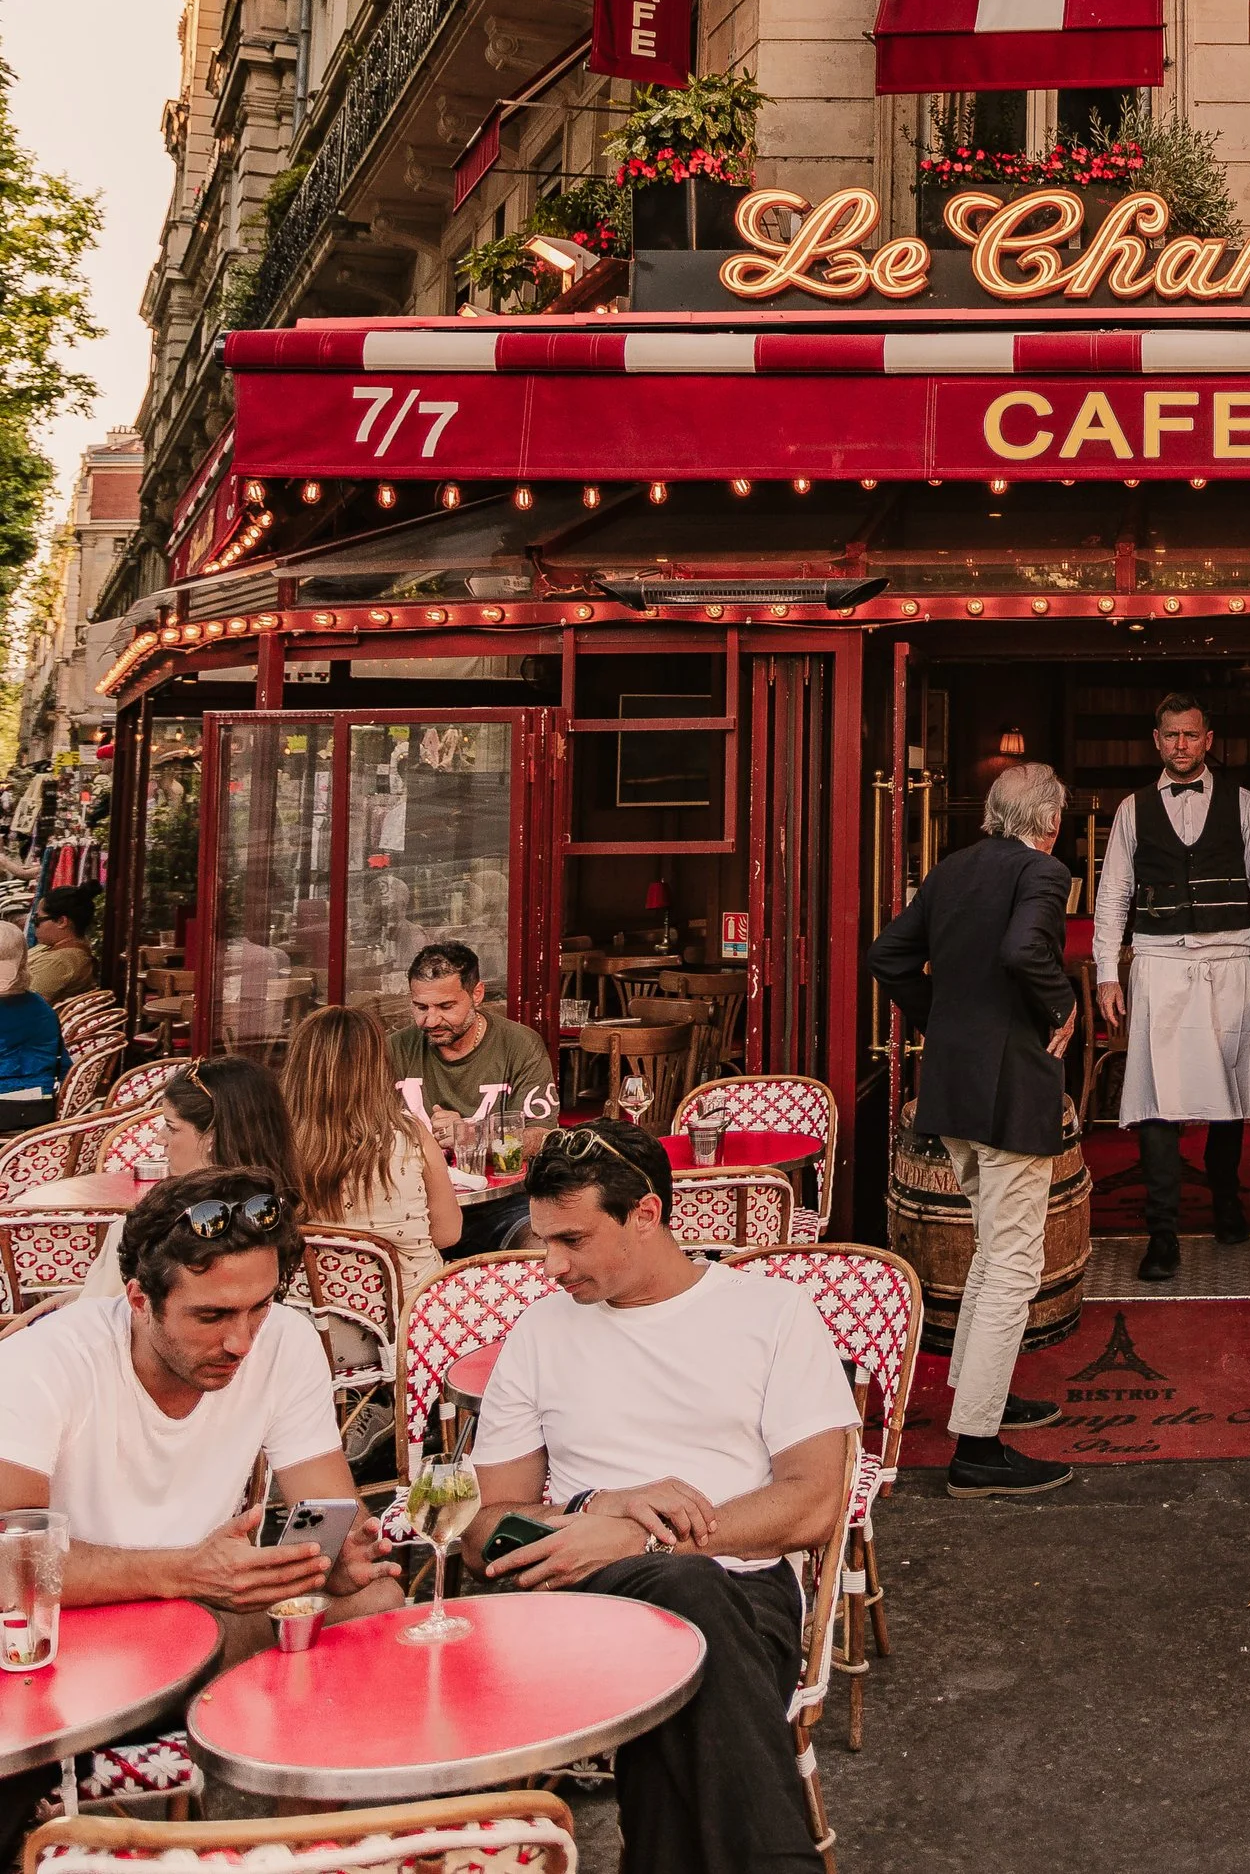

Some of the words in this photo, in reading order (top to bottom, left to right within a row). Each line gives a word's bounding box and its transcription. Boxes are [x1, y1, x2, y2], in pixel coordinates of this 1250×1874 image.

[718, 187, 931, 299] Le
[353, 386, 459, 457] 7/7
[931, 1169, 962, 1192] MA
[1066, 1388, 1177, 1403] BISTROT
[1152, 1406, 1215, 1425] de
